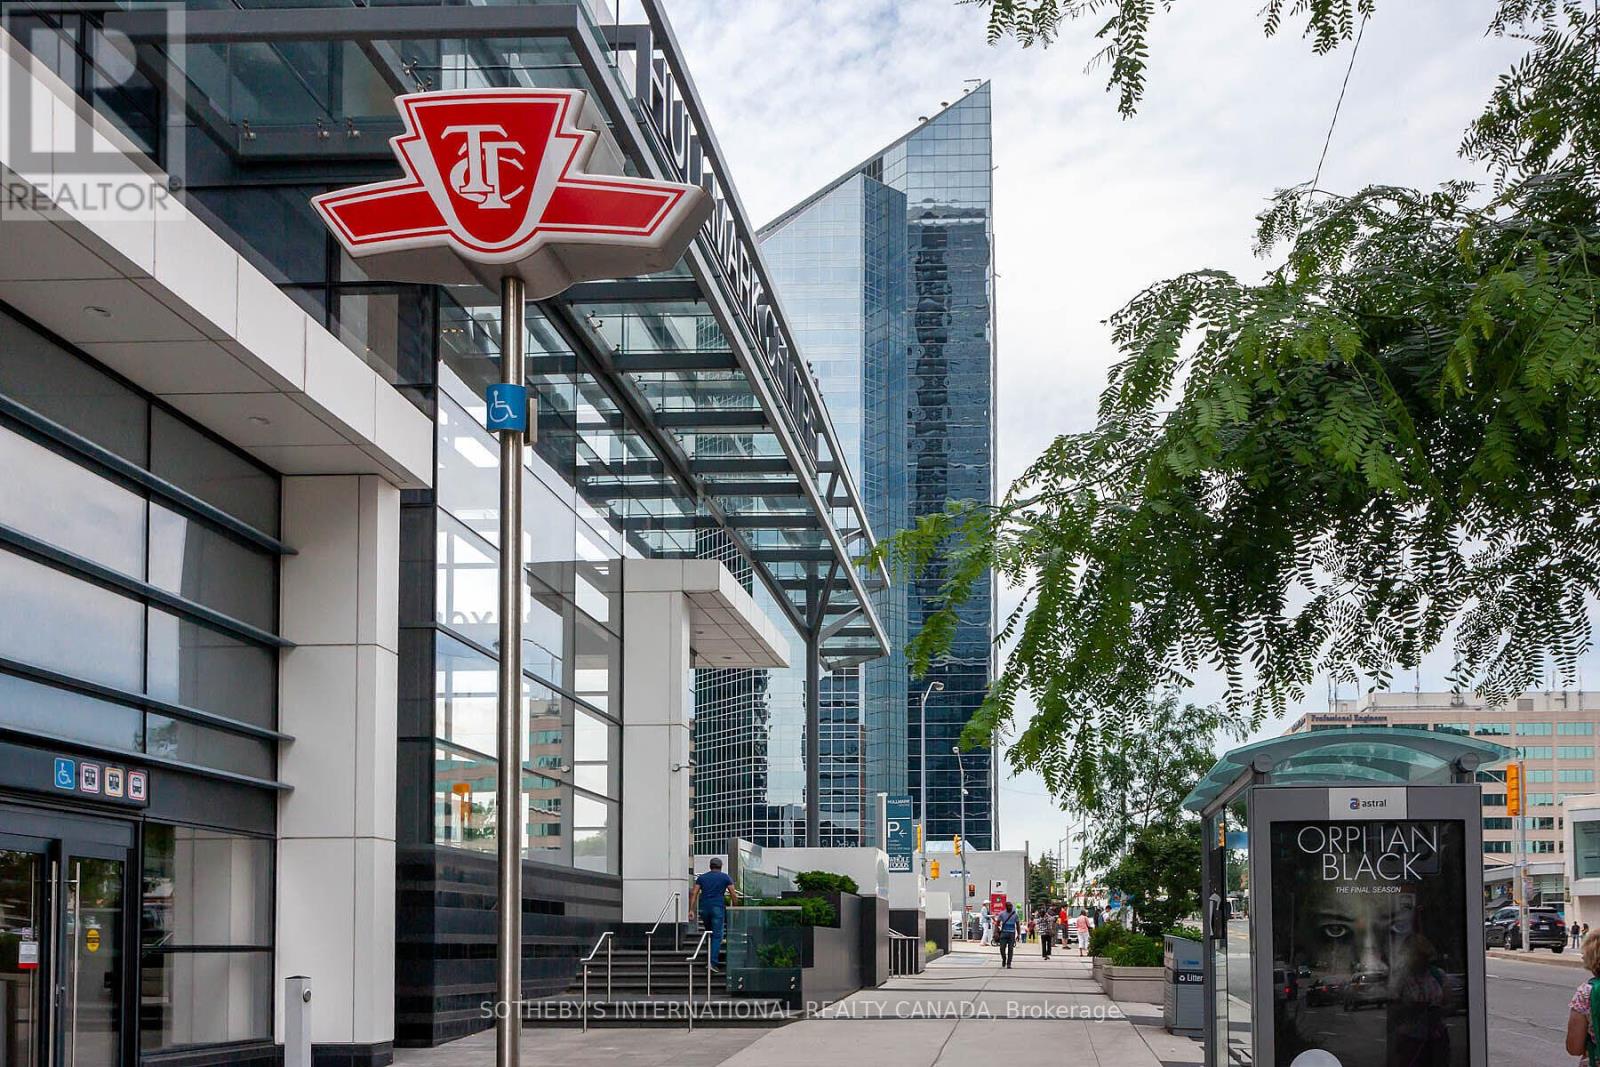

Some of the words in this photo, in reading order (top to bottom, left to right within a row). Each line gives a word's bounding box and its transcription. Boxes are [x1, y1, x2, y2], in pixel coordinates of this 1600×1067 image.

[1361, 799, 1387, 807] astral
[887, 821, 900, 838] P
[1322, 852, 1422, 880] BLACK
[1187, 973, 1204, 982] Litter
